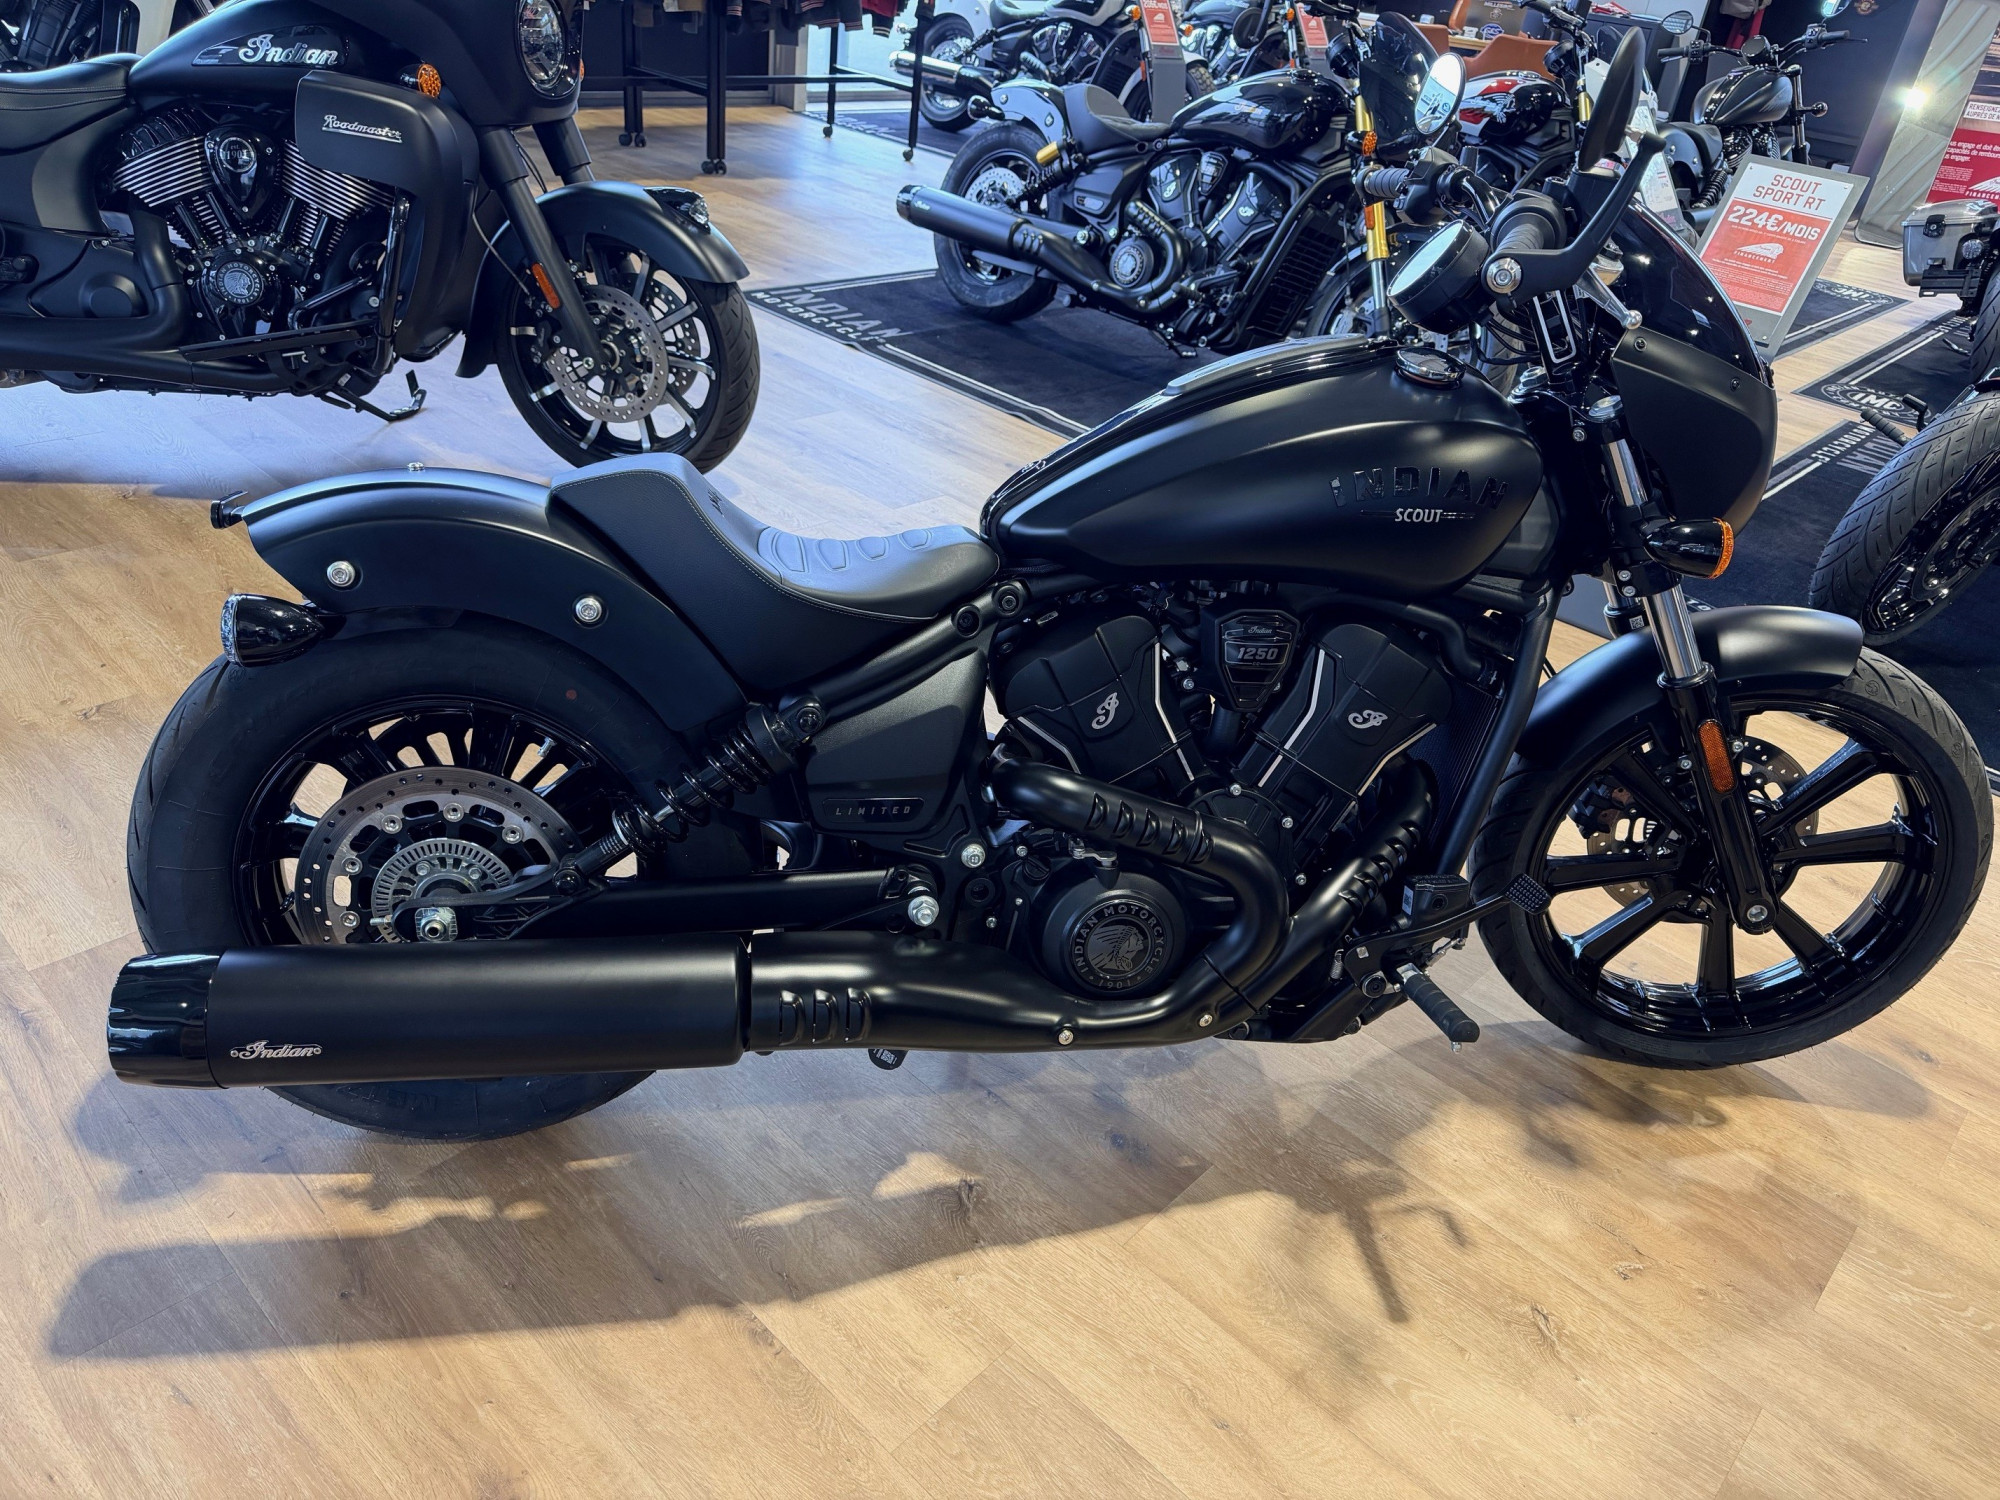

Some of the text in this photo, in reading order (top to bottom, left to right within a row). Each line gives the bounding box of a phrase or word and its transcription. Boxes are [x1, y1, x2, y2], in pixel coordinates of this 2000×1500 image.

[239, 34, 338, 65] Indian
[324, 115, 402, 139] Roadmaster
[1771, 174, 1822, 194] SCOUT
[1753, 186, 1826, 211] SPORT RT
[1965, 190, 2000, 200] FINANCEM
[1727, 205, 1821, 241] 224€/MOIS
[1733, 250, 1776, 264] FINANCEMENT
[750, 291, 880, 341] MOTORCYCLE
[769, 287, 914, 338] INDIAN
[1851, 392, 1901, 411] IMC
[1329, 467, 1510, 510] INDIAN
[1394, 507, 1443, 523] SCOUT
[1247, 625, 1273, 634] Indian
[1237, 647, 1279, 660] 1250
[835, 806, 911, 816] LIMITED
[1074, 904, 1165, 974] INDIAN MOTORCYCLE
[239, 1040, 314, 1060] Indian
